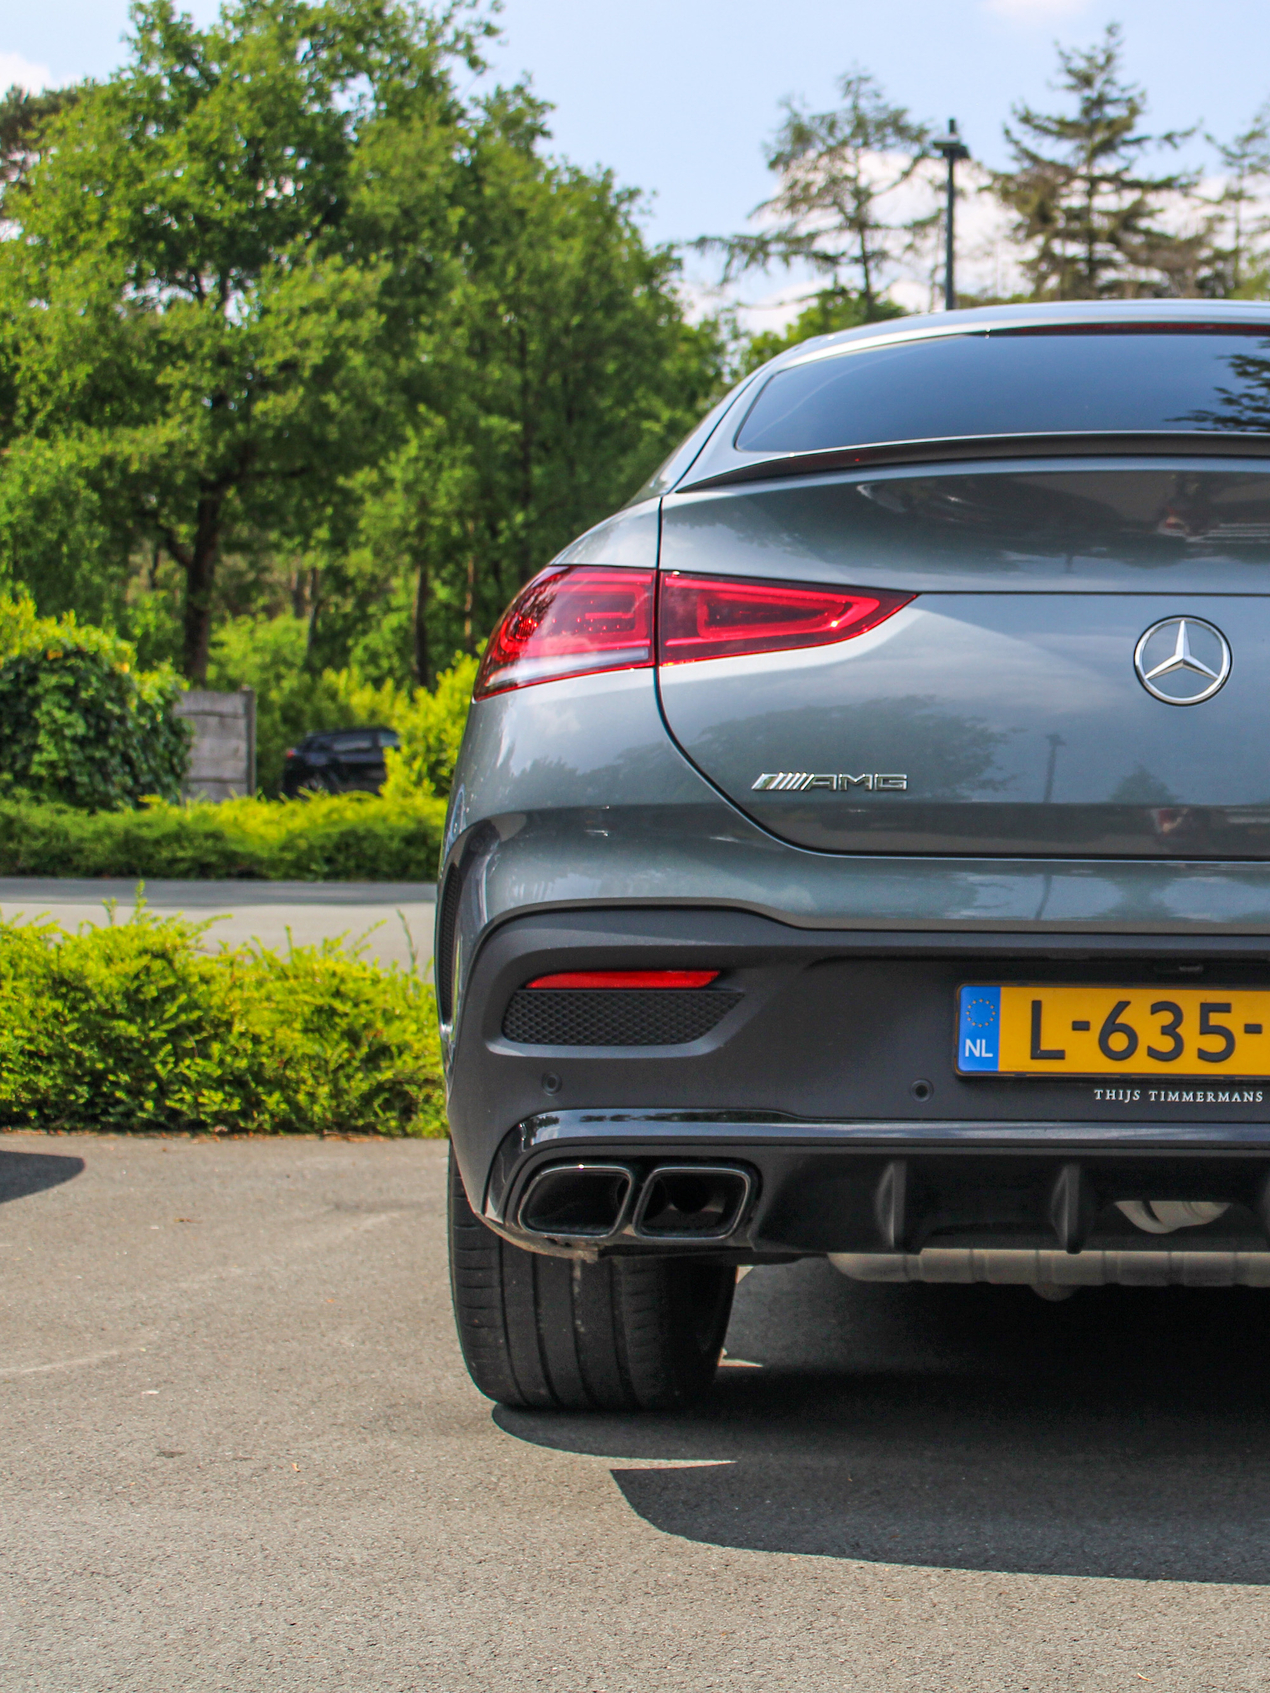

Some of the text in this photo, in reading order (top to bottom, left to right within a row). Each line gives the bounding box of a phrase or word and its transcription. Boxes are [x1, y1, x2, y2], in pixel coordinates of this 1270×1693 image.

[800, 772, 908, 792] AMG
[964, 1038, 994, 1058] NL
[1093, 1089, 1264, 1104] THIJS TIMMERMANS
